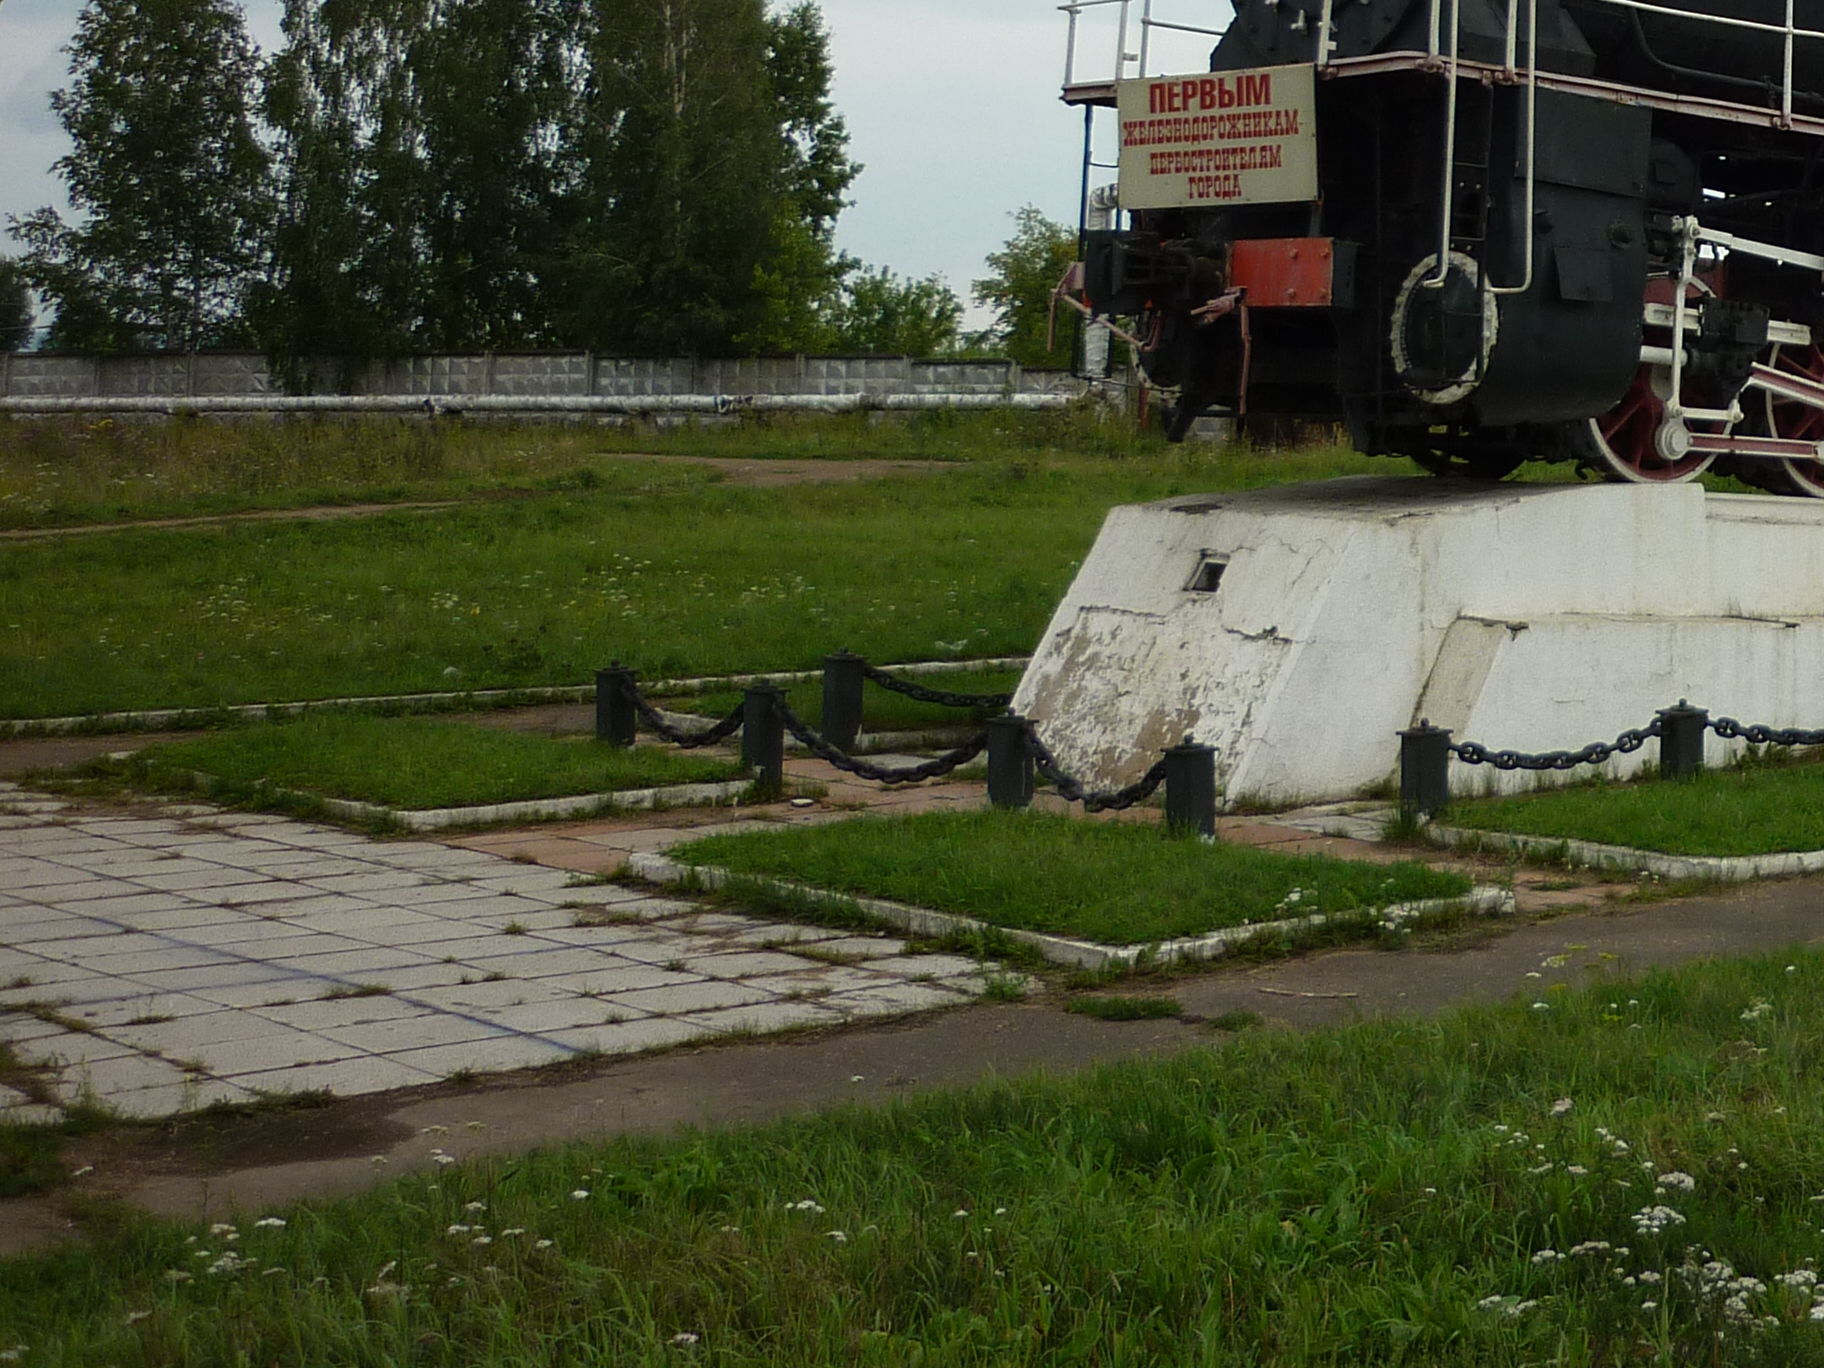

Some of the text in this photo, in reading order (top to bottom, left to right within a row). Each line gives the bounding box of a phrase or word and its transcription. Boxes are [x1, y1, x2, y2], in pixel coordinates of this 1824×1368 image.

[1149, 73, 1271, 113] ПЕРВЫМ
[1149, 144, 1282, 175] ПЕРВОСТРОИТЕЛЯМ
[1189, 174, 1242, 200] ГОРОДА
